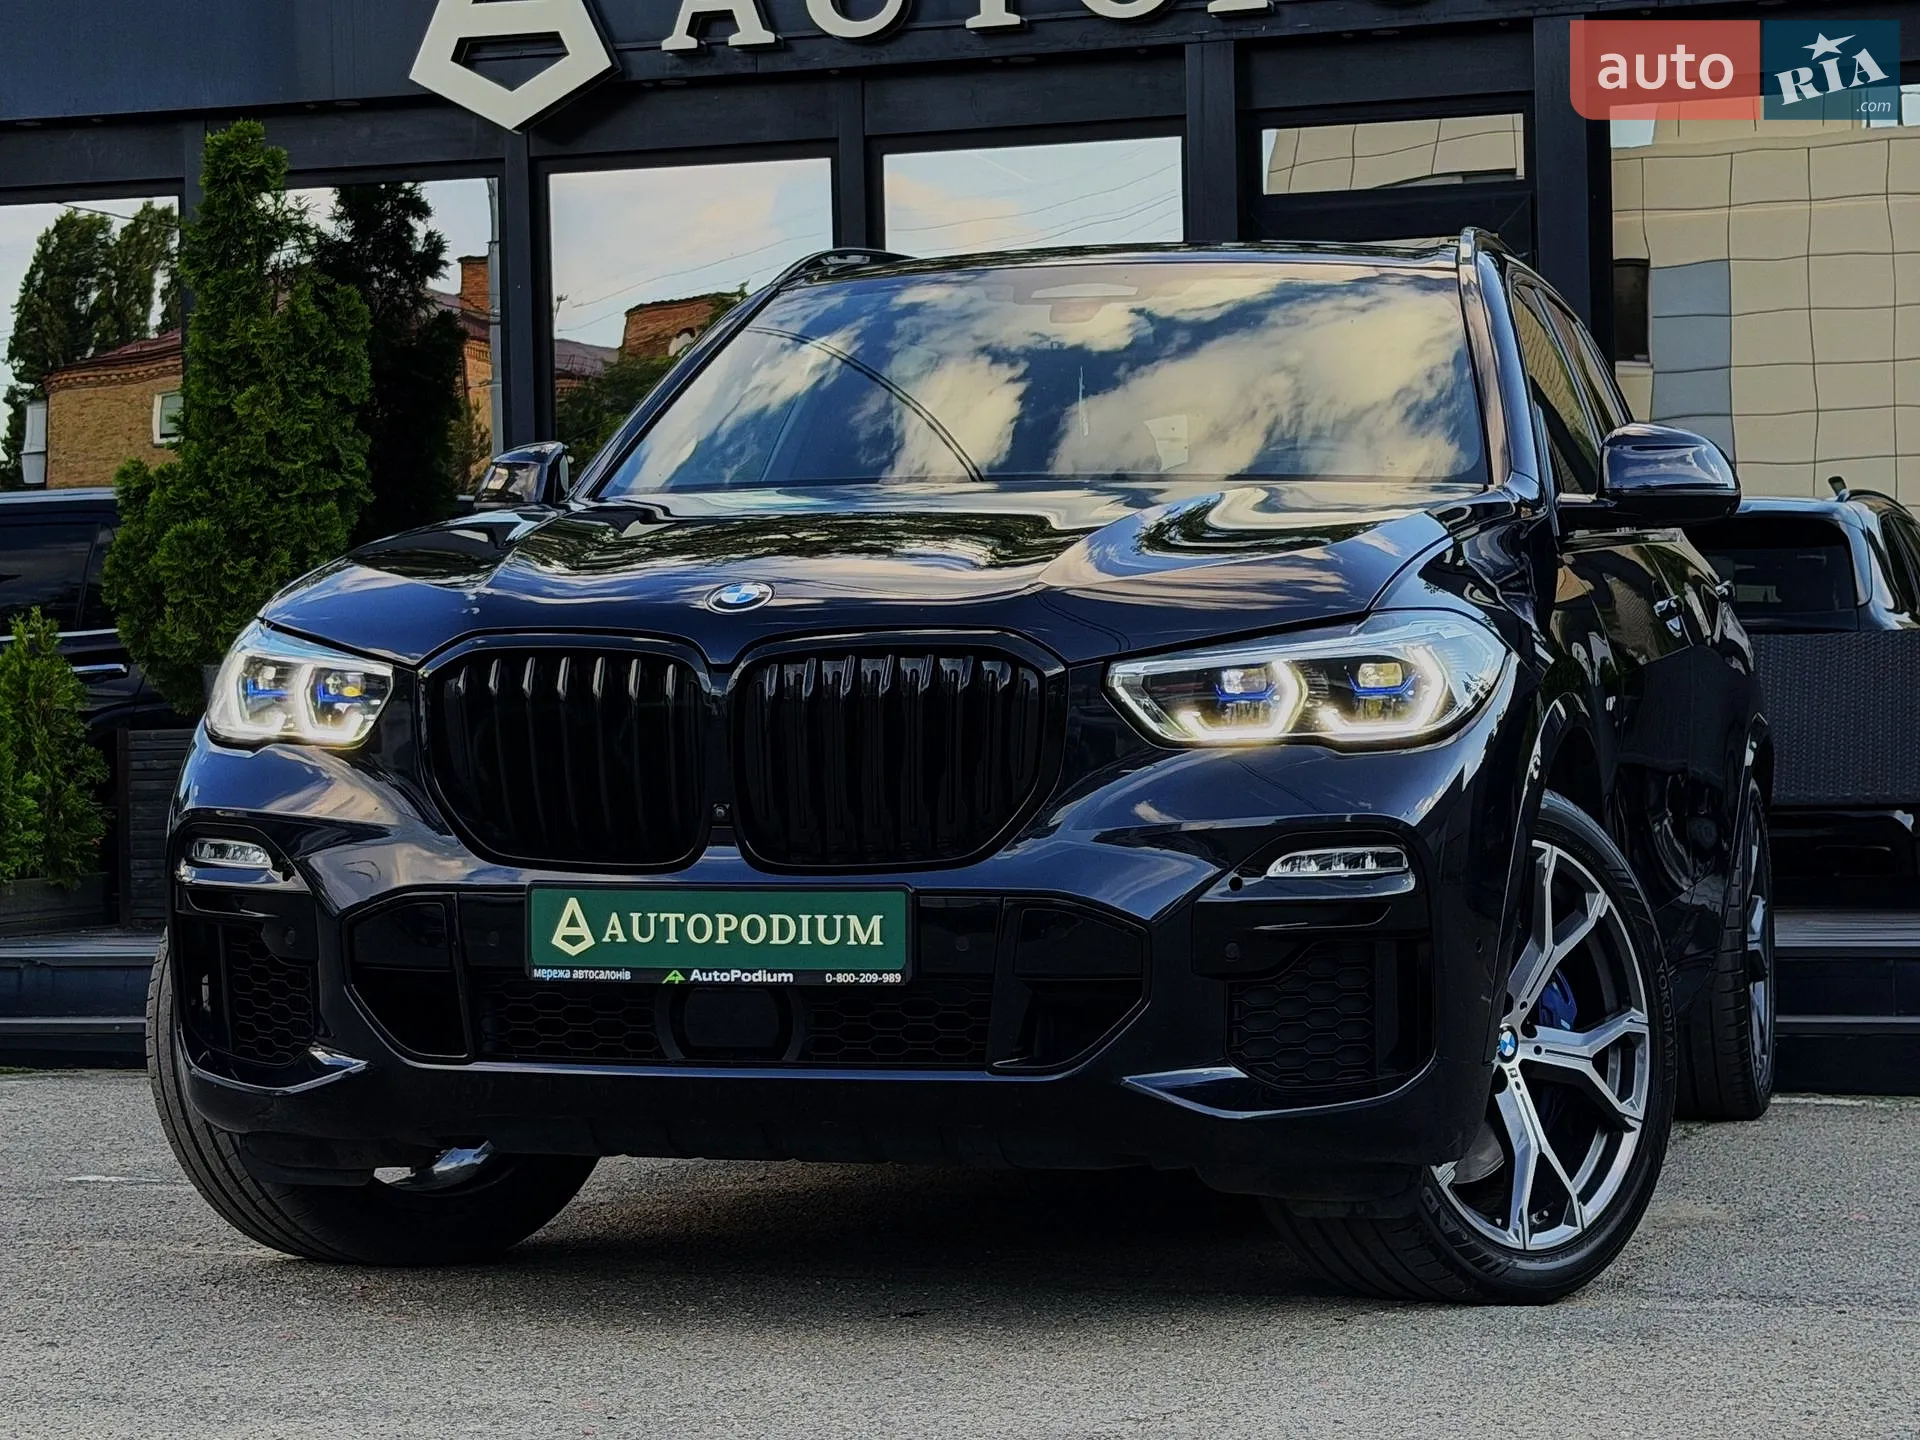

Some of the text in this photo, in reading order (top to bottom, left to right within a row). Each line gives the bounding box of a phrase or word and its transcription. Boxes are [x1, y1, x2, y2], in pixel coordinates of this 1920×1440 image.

[601, 911, 885, 946] AUTOPODIUM
[533, 968, 632, 981] мережа автосалонів
[689, 969, 794, 984] AutoPodium
[825, 972, 902, 984] 0-800-209-989
